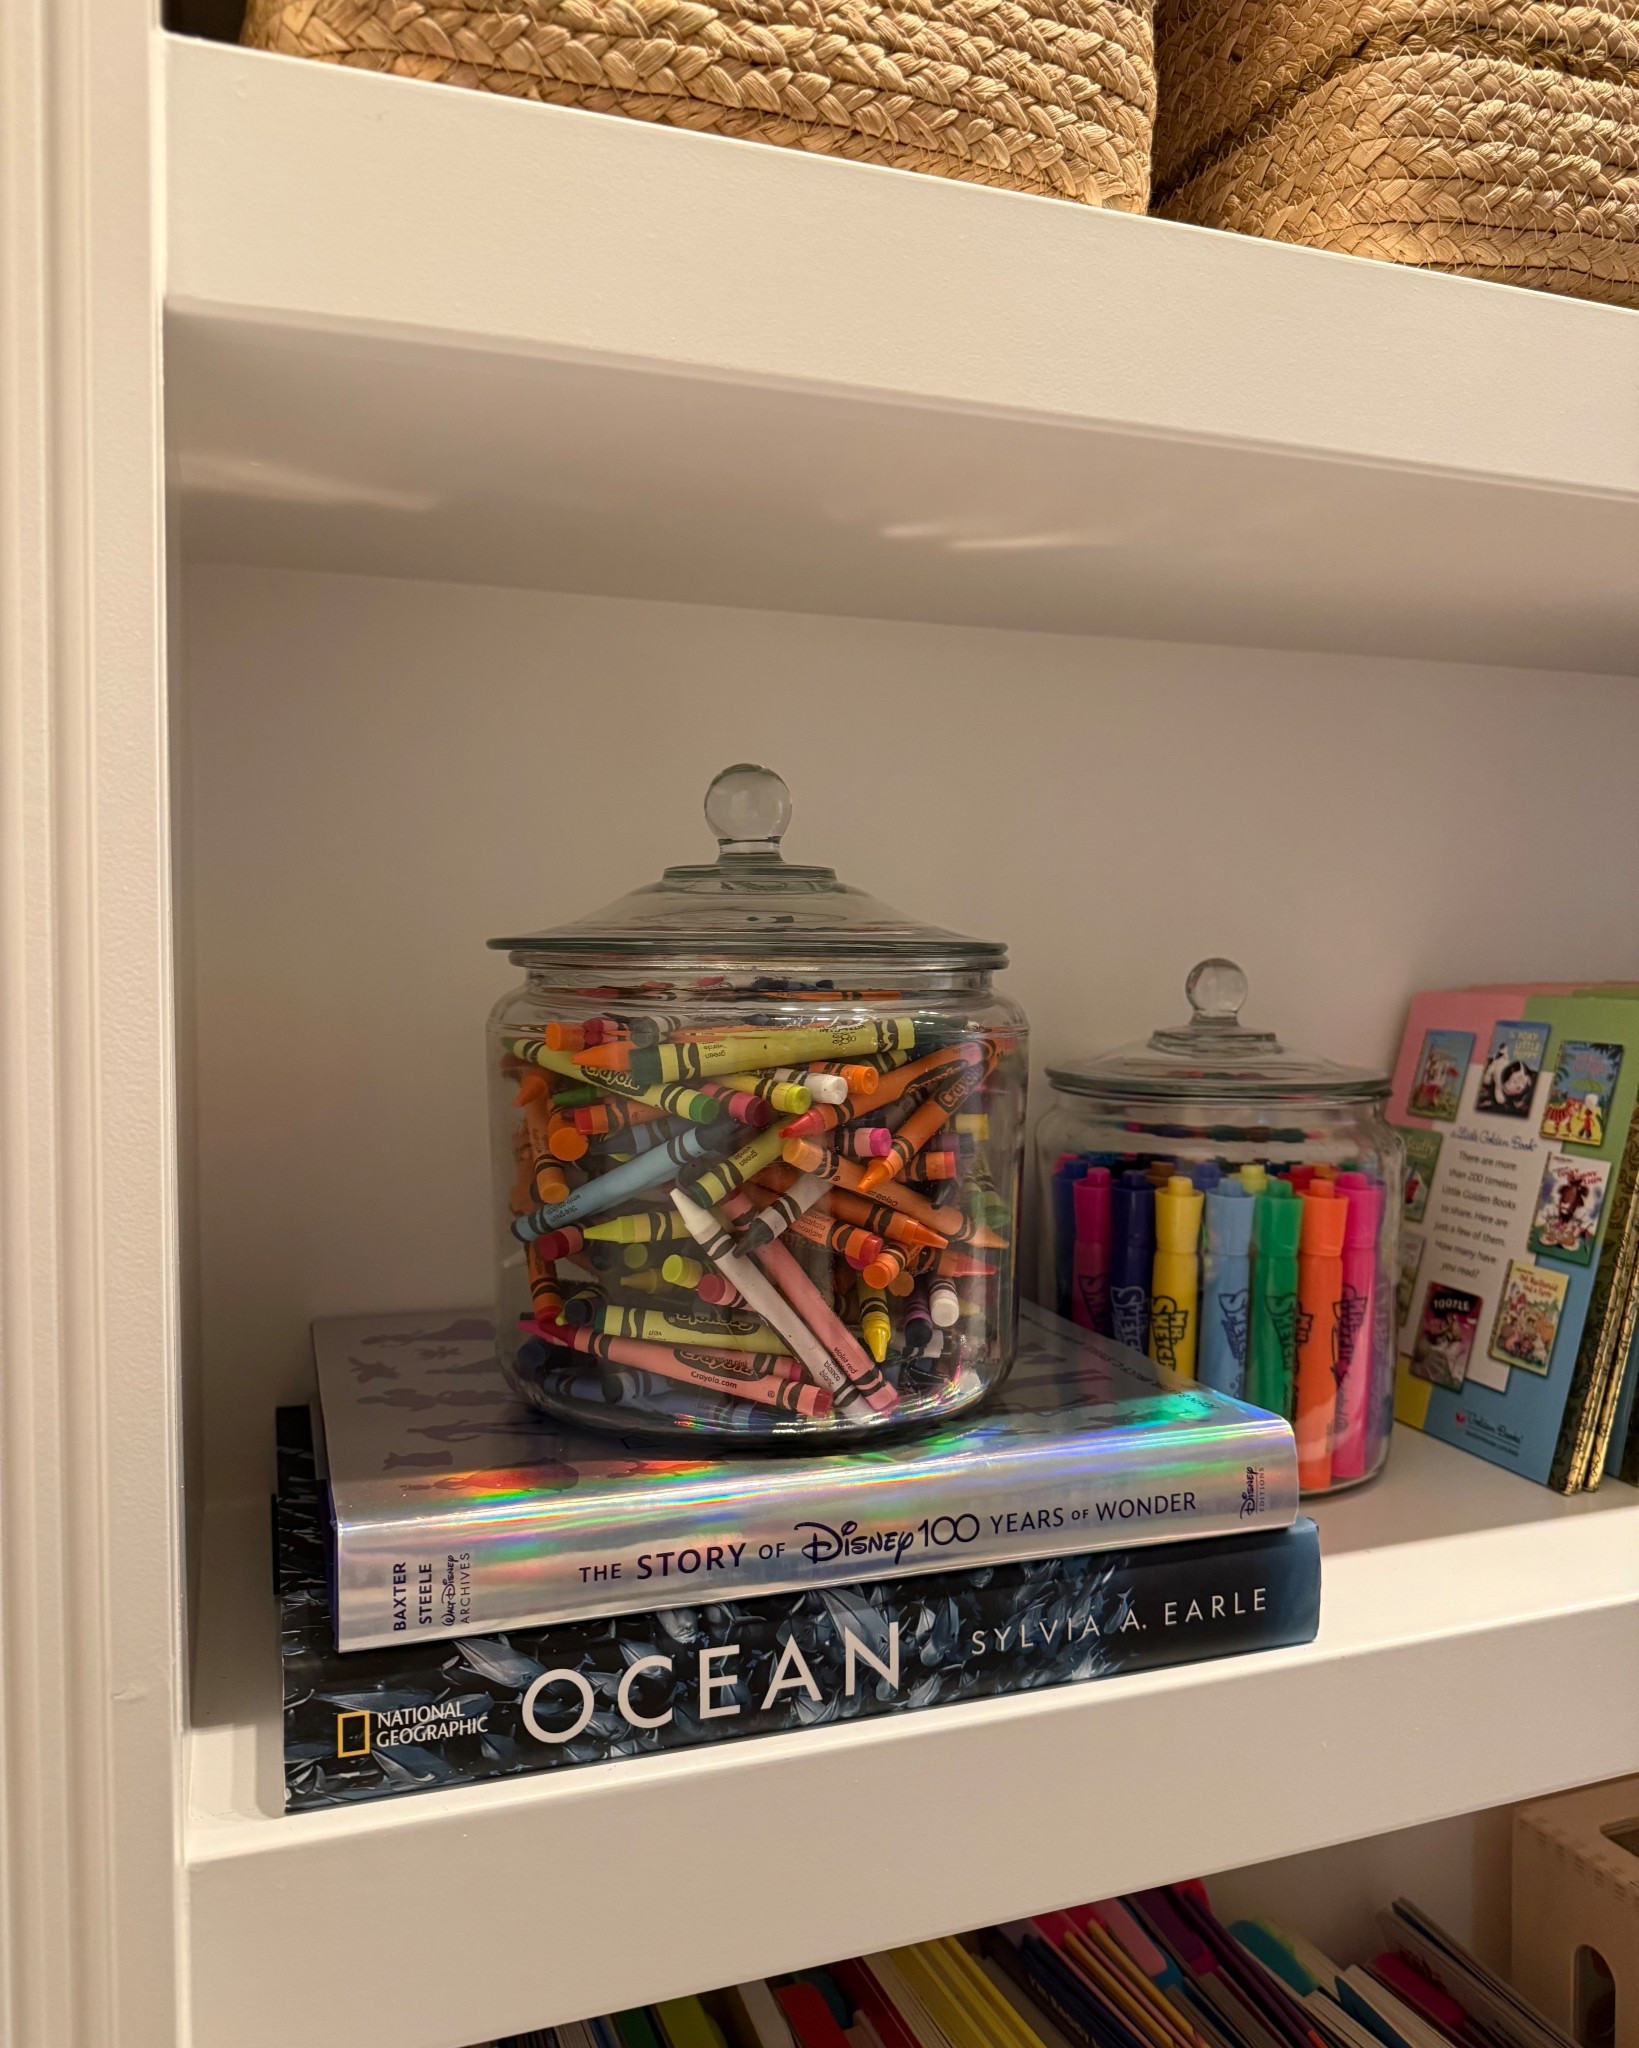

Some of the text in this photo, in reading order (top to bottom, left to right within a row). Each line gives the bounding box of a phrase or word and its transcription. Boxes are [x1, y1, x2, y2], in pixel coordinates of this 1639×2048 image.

[739, 1149, 758, 1167] green
[1459, 1151, 1517, 1171] There are more
[1449, 1168, 1518, 1190] than 200 timeless
[865, 1190, 898, 1207] Crayola.co
[1442, 1186, 1516, 1210] Little Golden Books
[1451, 1206, 1473, 1219] share.
[1475, 1212, 1494, 1225] Here
[1495, 1217, 1509, 1227] are
[1457, 1227, 1472, 1237] few
[1472, 1229, 1482, 1239] of
[1483, 1232, 1505, 1246] them.
[1435, 1240, 1497, 1264] How many have
[1440, 1262, 1480, 1278] you read?
[1169, 1309, 1189, 1345] MR.
[823, 1360, 841, 1381] blanco
[834, 1347, 848, 1363] violet
[846, 1363, 858, 1374] red
[691, 1370, 737, 1389] Crayola.com
[819, 1369, 834, 1387] blanc
[1258, 1466, 1266, 1512] EDITIONS
[579, 1561, 622, 1583] THE
[636, 1542, 747, 1581] STORY
[758, 1541, 785, 1561] OF
[917, 1512, 981, 1549] 100
[989, 1506, 1065, 1535] YEARS
[1071, 1507, 1090, 1521] OF
[1095, 1490, 1197, 1522] WONDER
[392, 1561, 407, 1631] BAXTER
[418, 1563, 433, 1625] STEELE
[459, 1552, 471, 1624] ARCHIVES
[521, 1587, 1267, 1744] OCEAN SYLVIA A. EARLE
[376, 1701, 466, 1729] NATIONAL
[375, 1716, 489, 1748] GEOGRAPHIC
